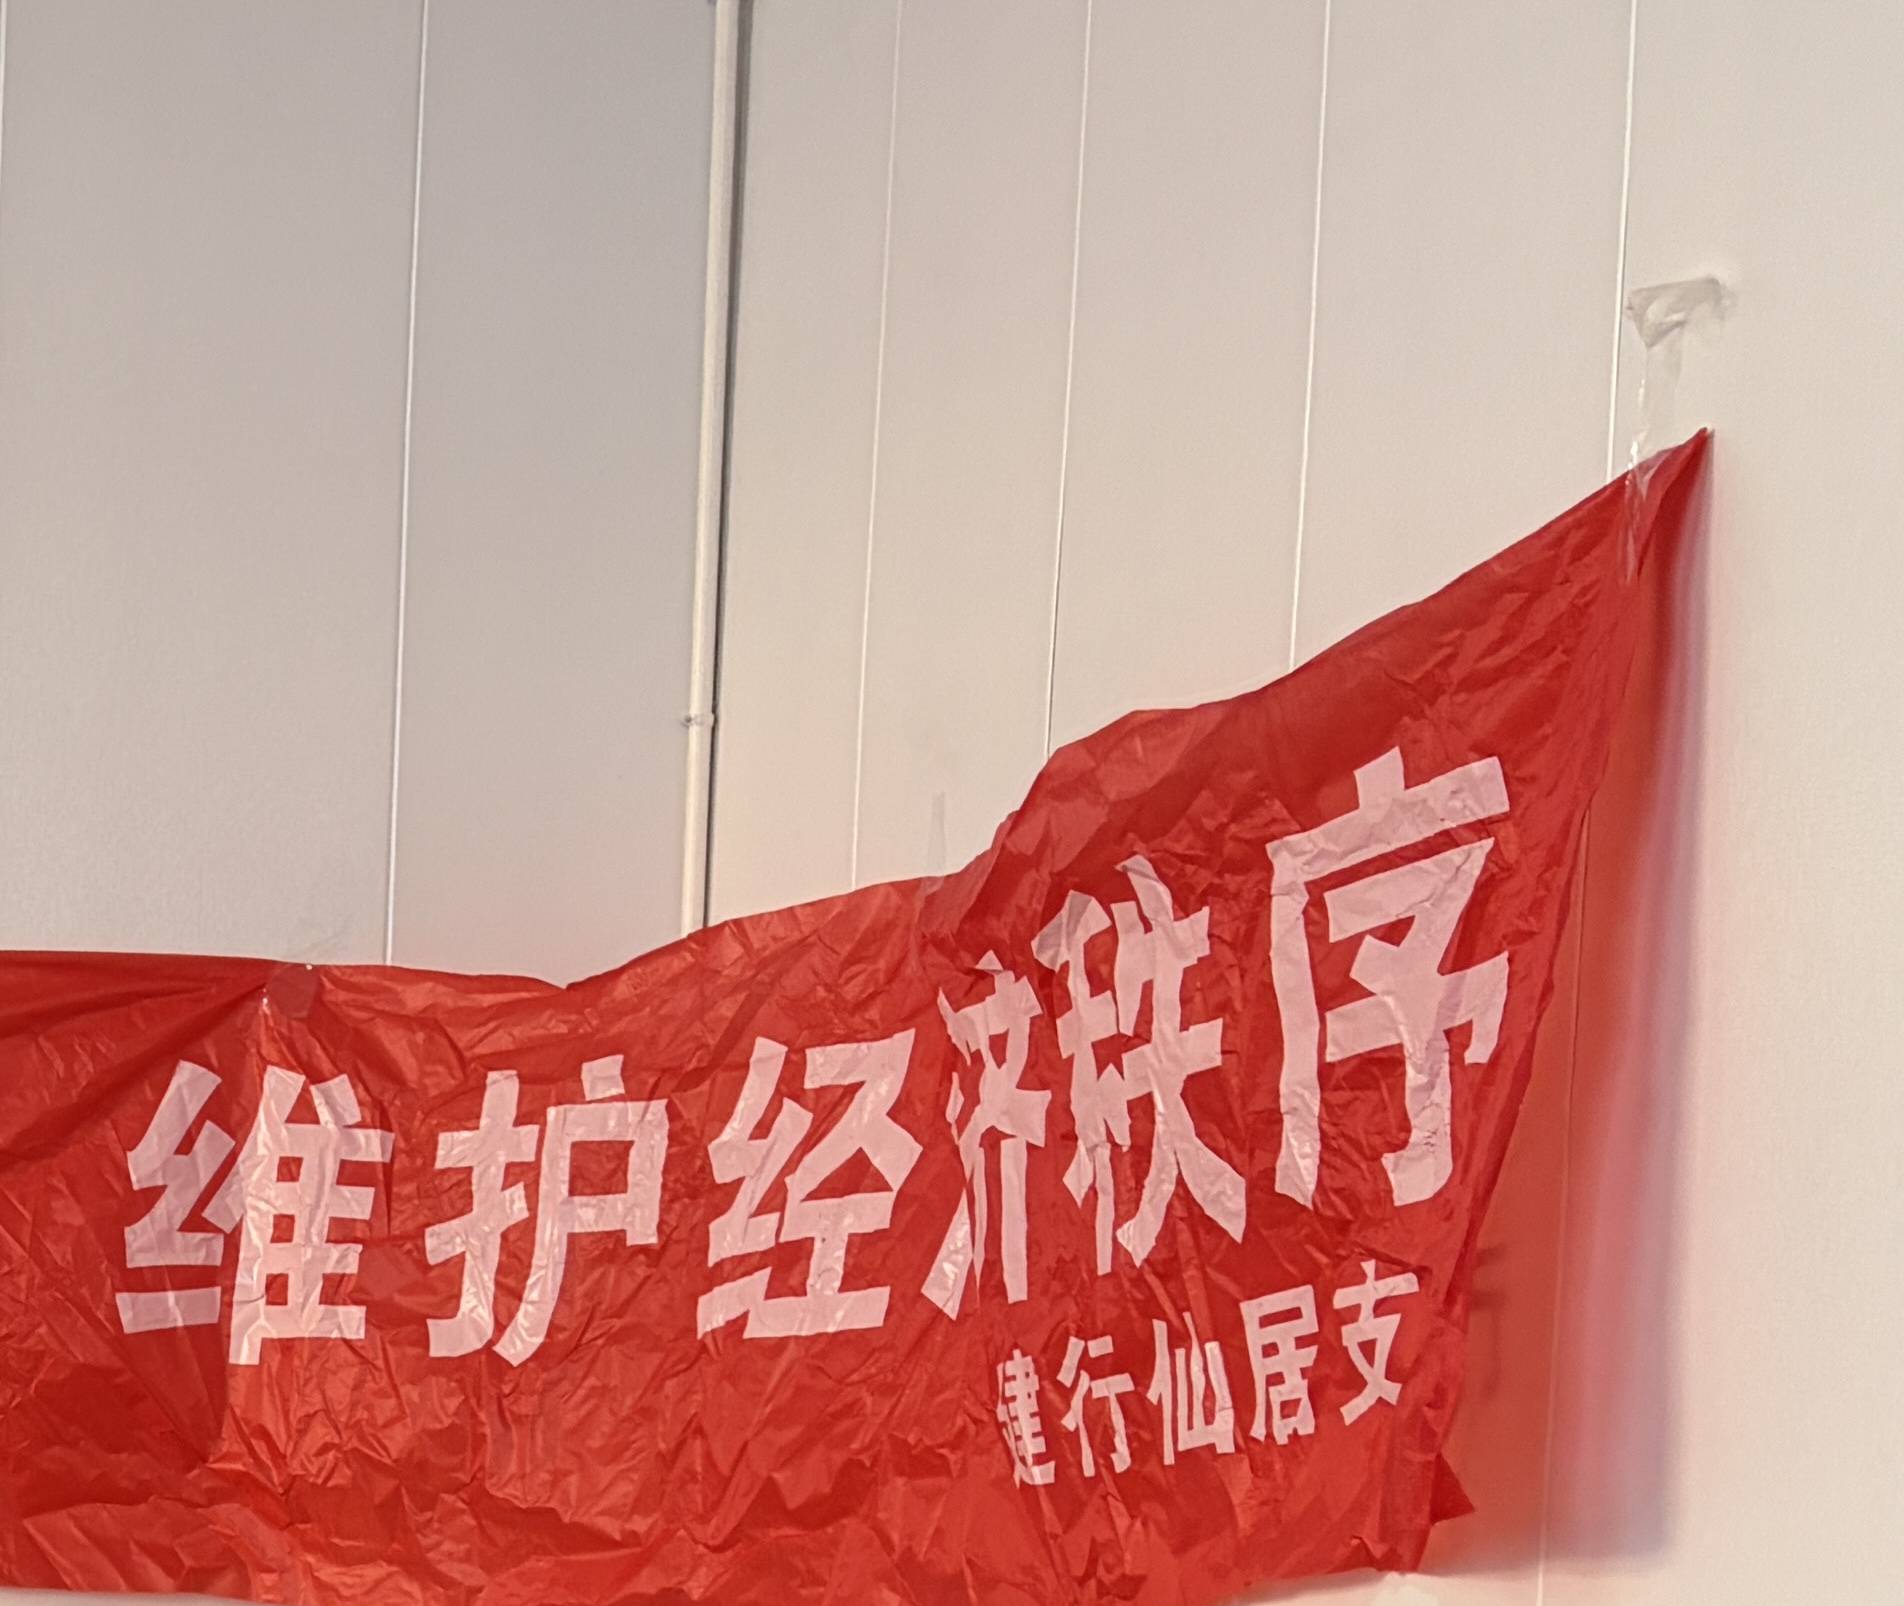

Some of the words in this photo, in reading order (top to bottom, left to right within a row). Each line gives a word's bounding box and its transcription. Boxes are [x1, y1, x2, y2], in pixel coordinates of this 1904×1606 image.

[115, 746, 1510, 1367] 维护经济秩序
[996, 1259, 1420, 1488] 建行仙居支
